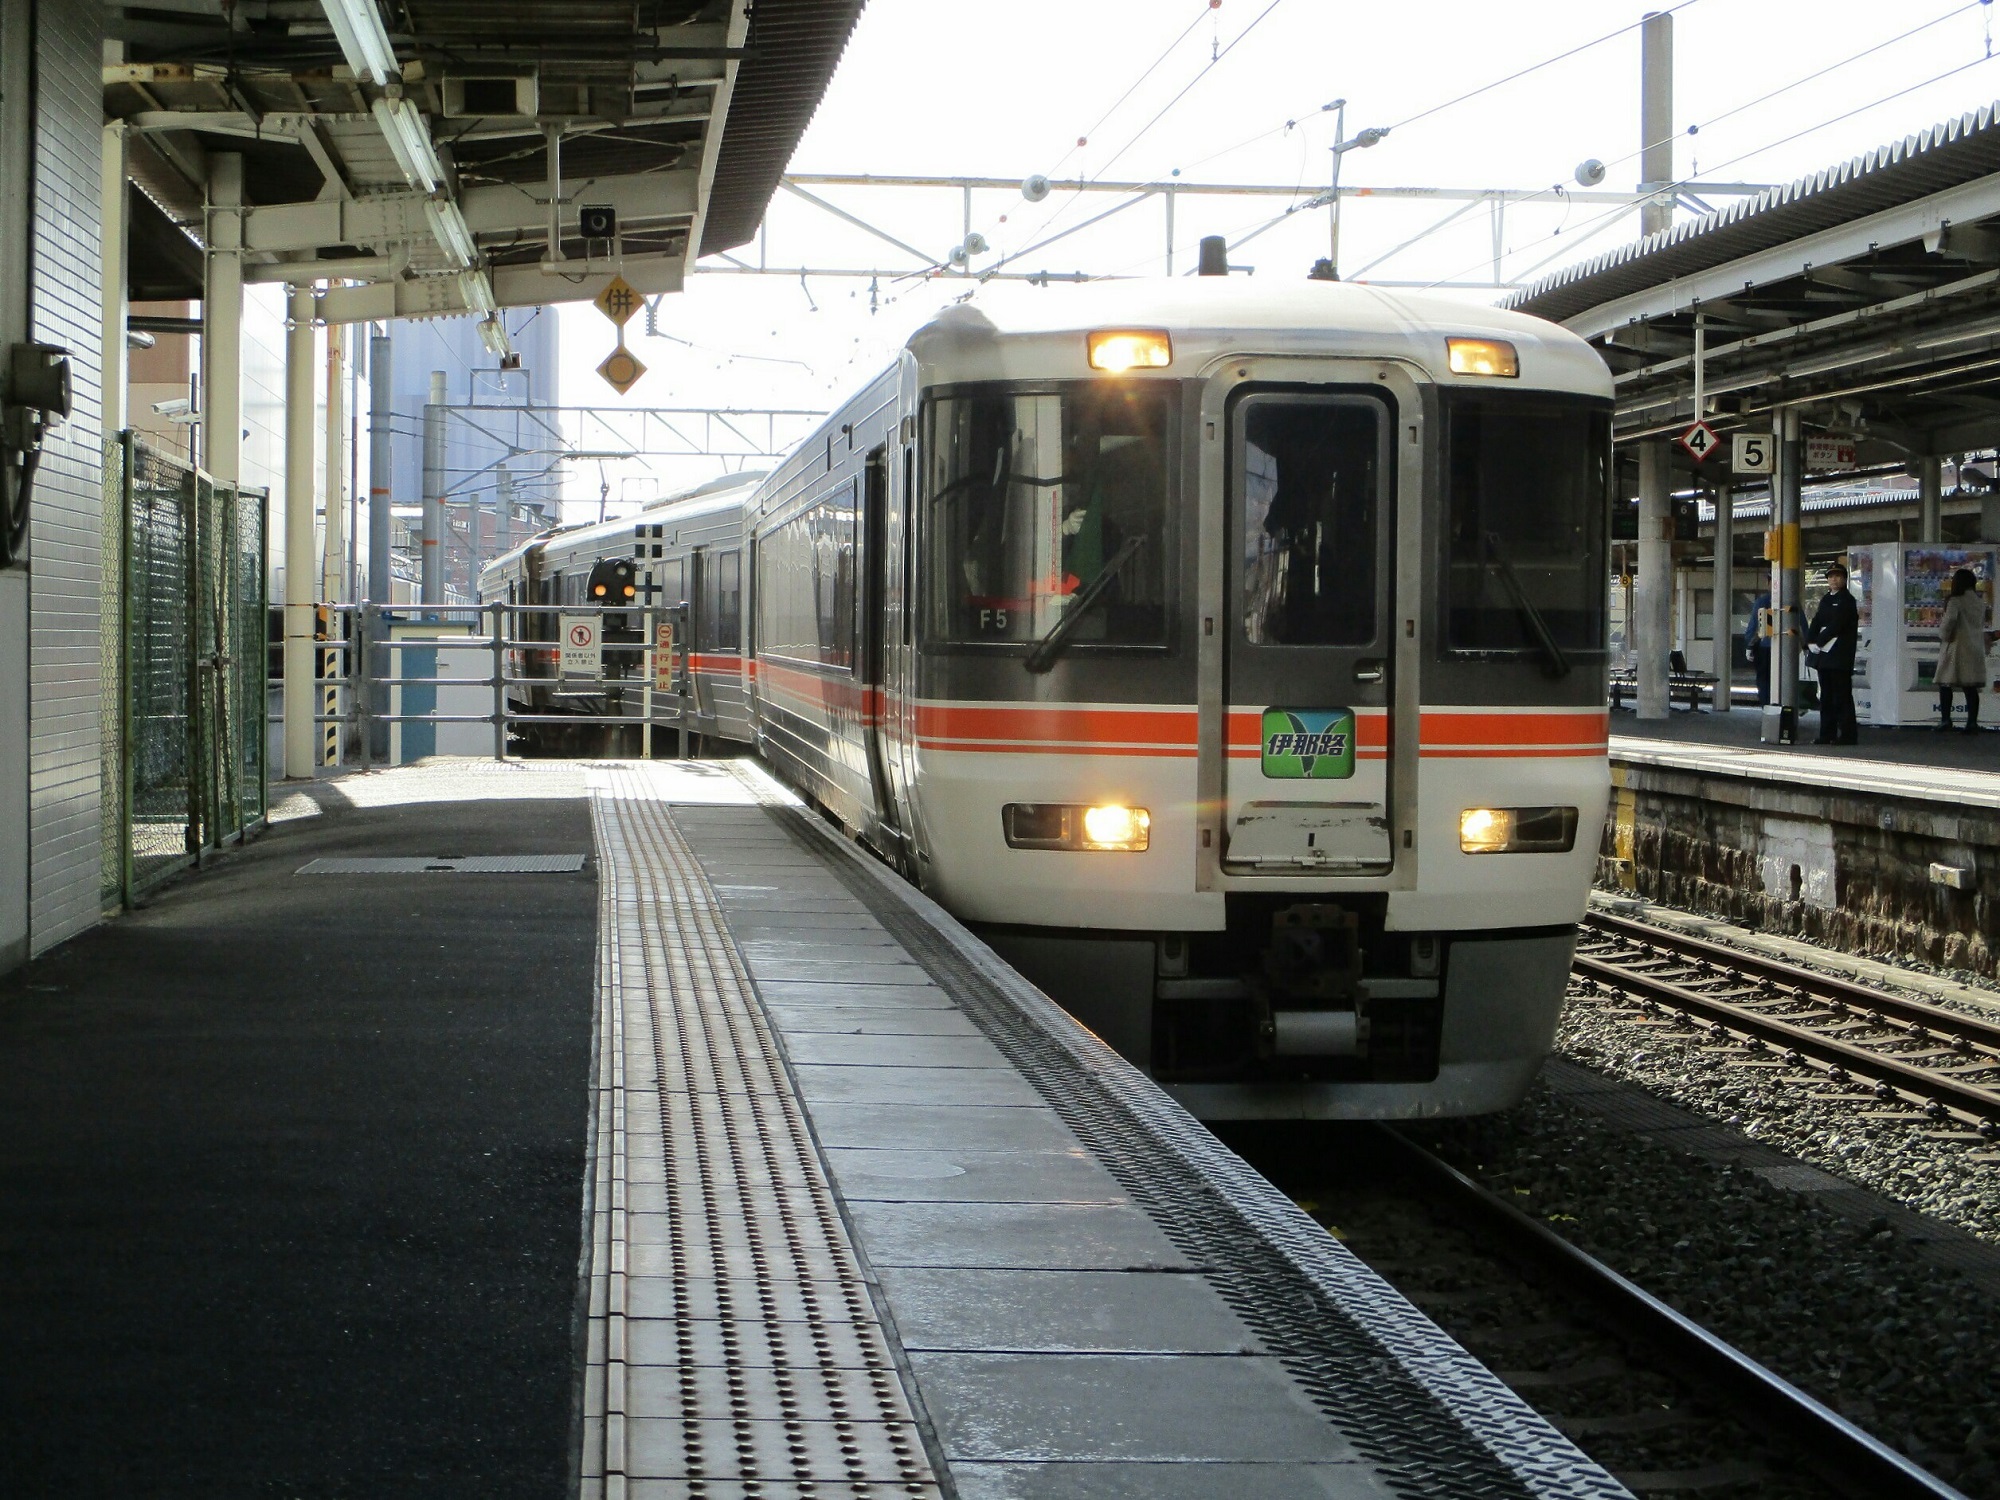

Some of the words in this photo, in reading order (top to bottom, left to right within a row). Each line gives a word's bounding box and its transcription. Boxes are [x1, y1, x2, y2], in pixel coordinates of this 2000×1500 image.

[605, 288, 633, 316] 併
[1690, 429, 1707, 452] 4
[1744, 440, 1764, 466] 5
[1680, 505, 1688, 515] 6
[658, 640, 670, 689] 通行禁止
[1267, 733, 1347, 756] 伊那路
